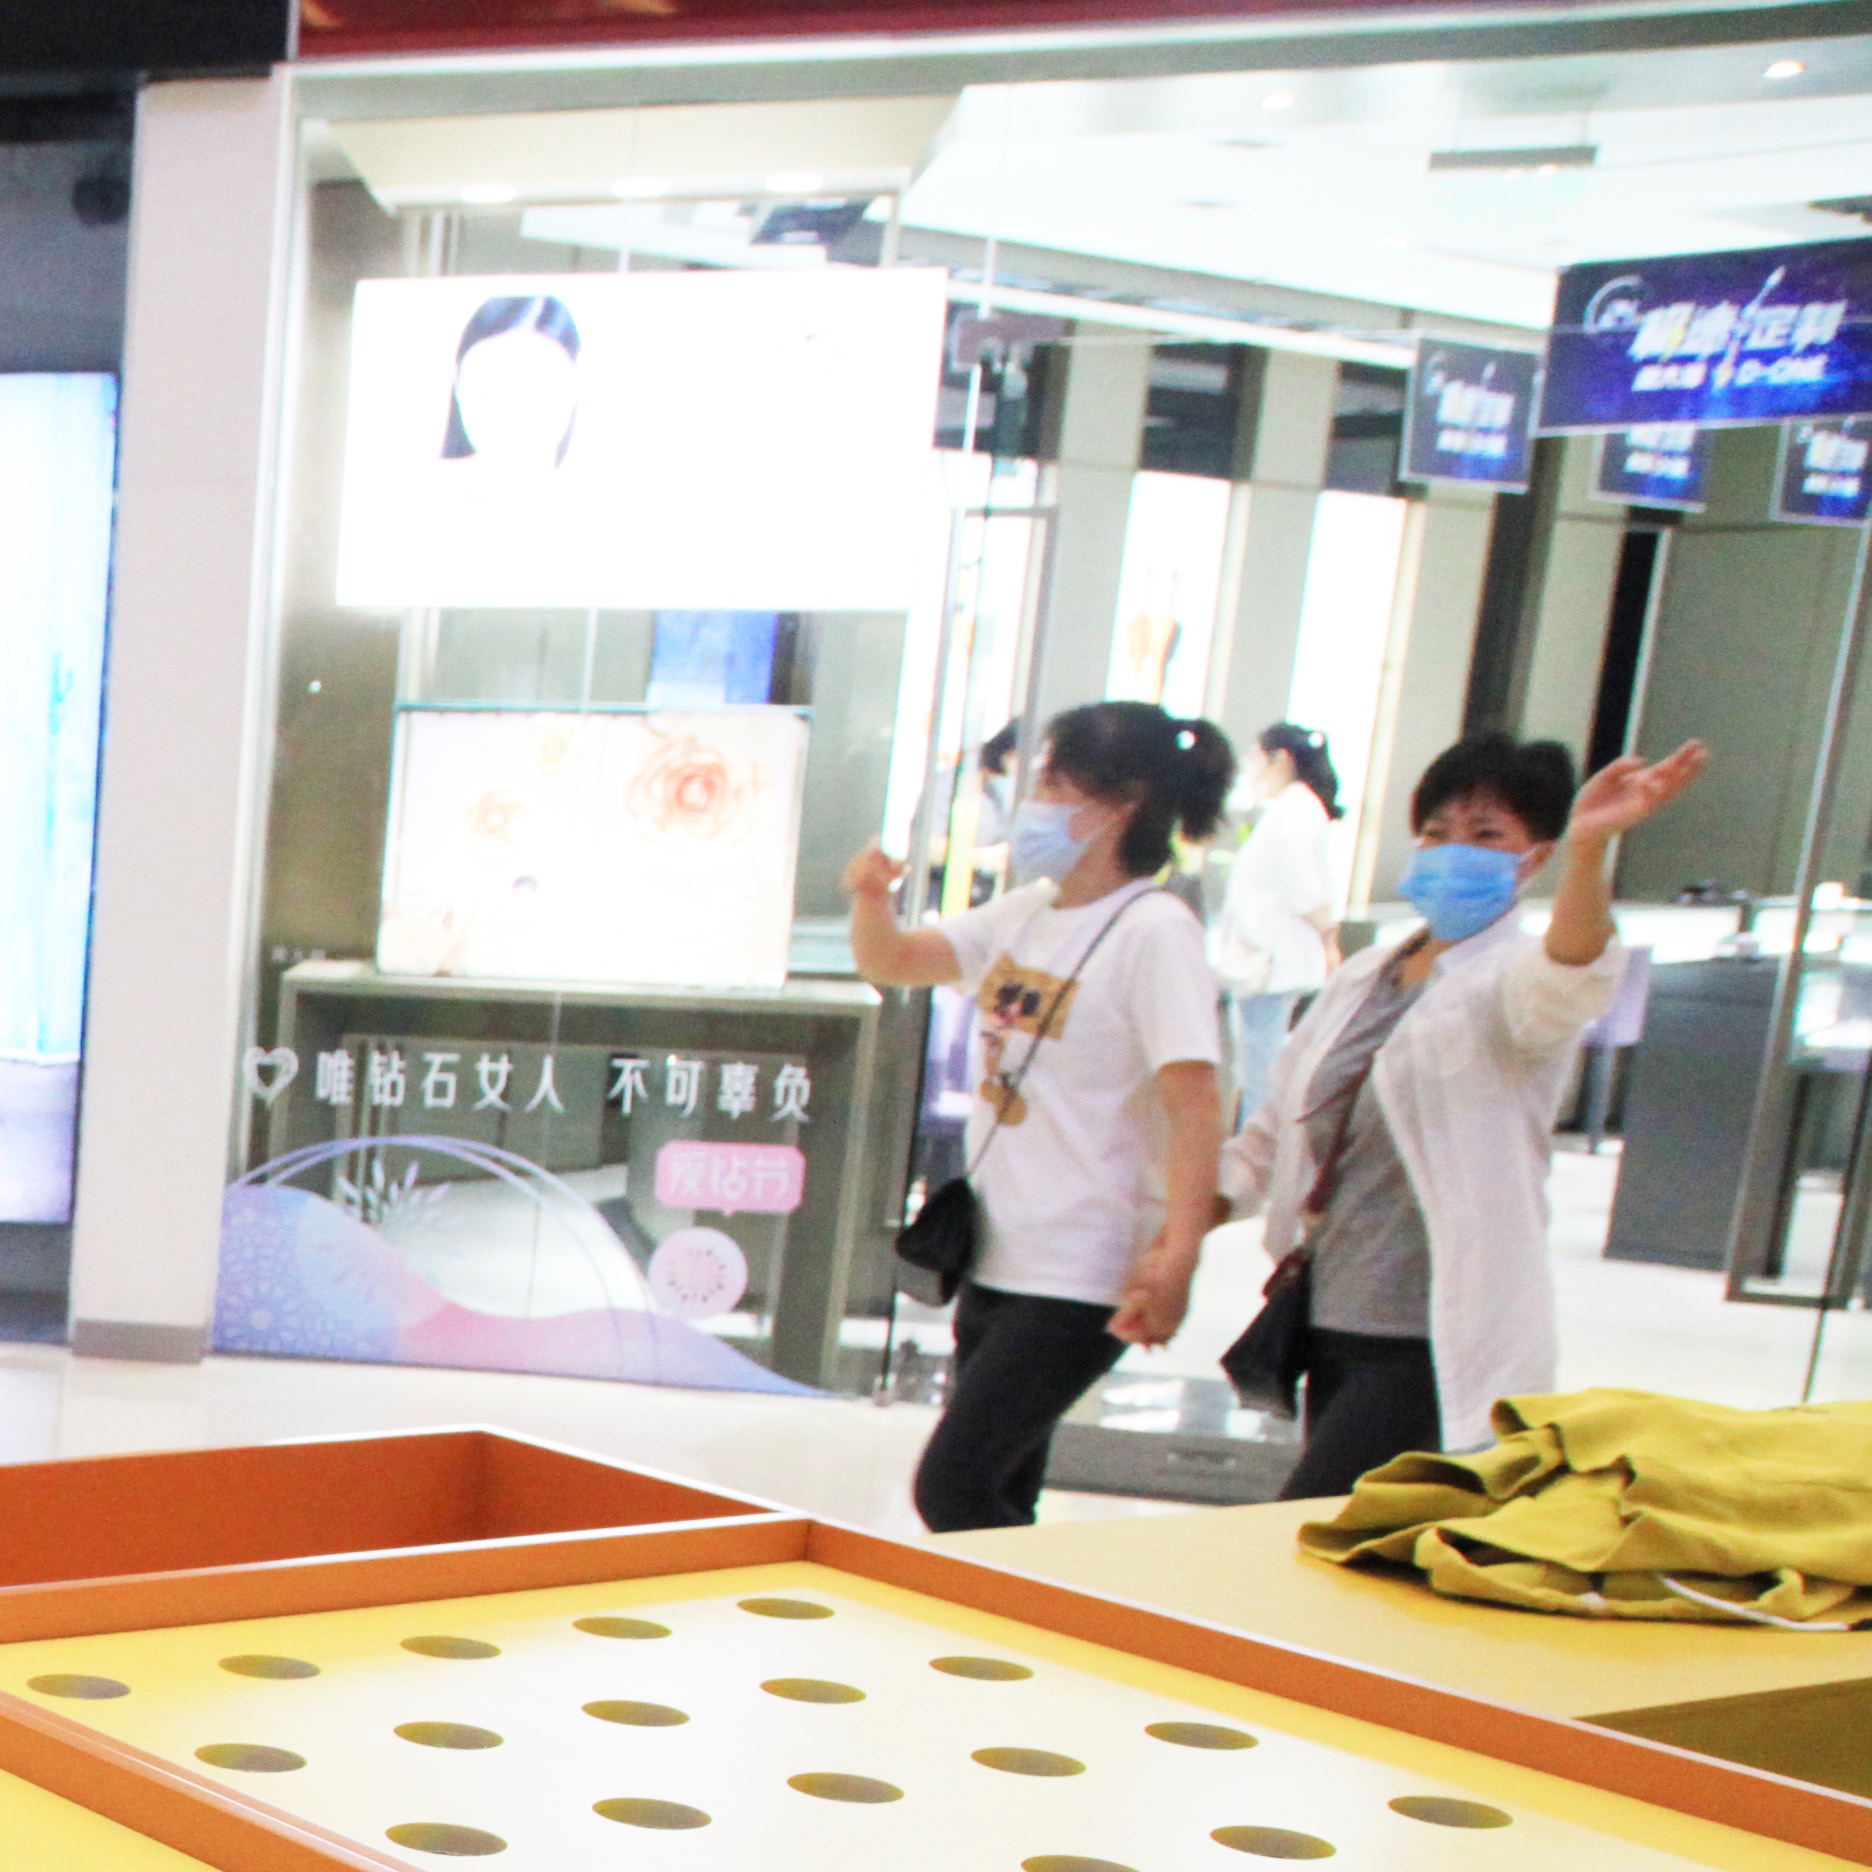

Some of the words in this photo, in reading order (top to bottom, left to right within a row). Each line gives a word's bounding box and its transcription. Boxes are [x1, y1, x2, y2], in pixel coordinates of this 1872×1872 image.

[316, 1050, 564, 1114] 唯钻石女人
[608, 1054, 810, 1123] 不可辜负
